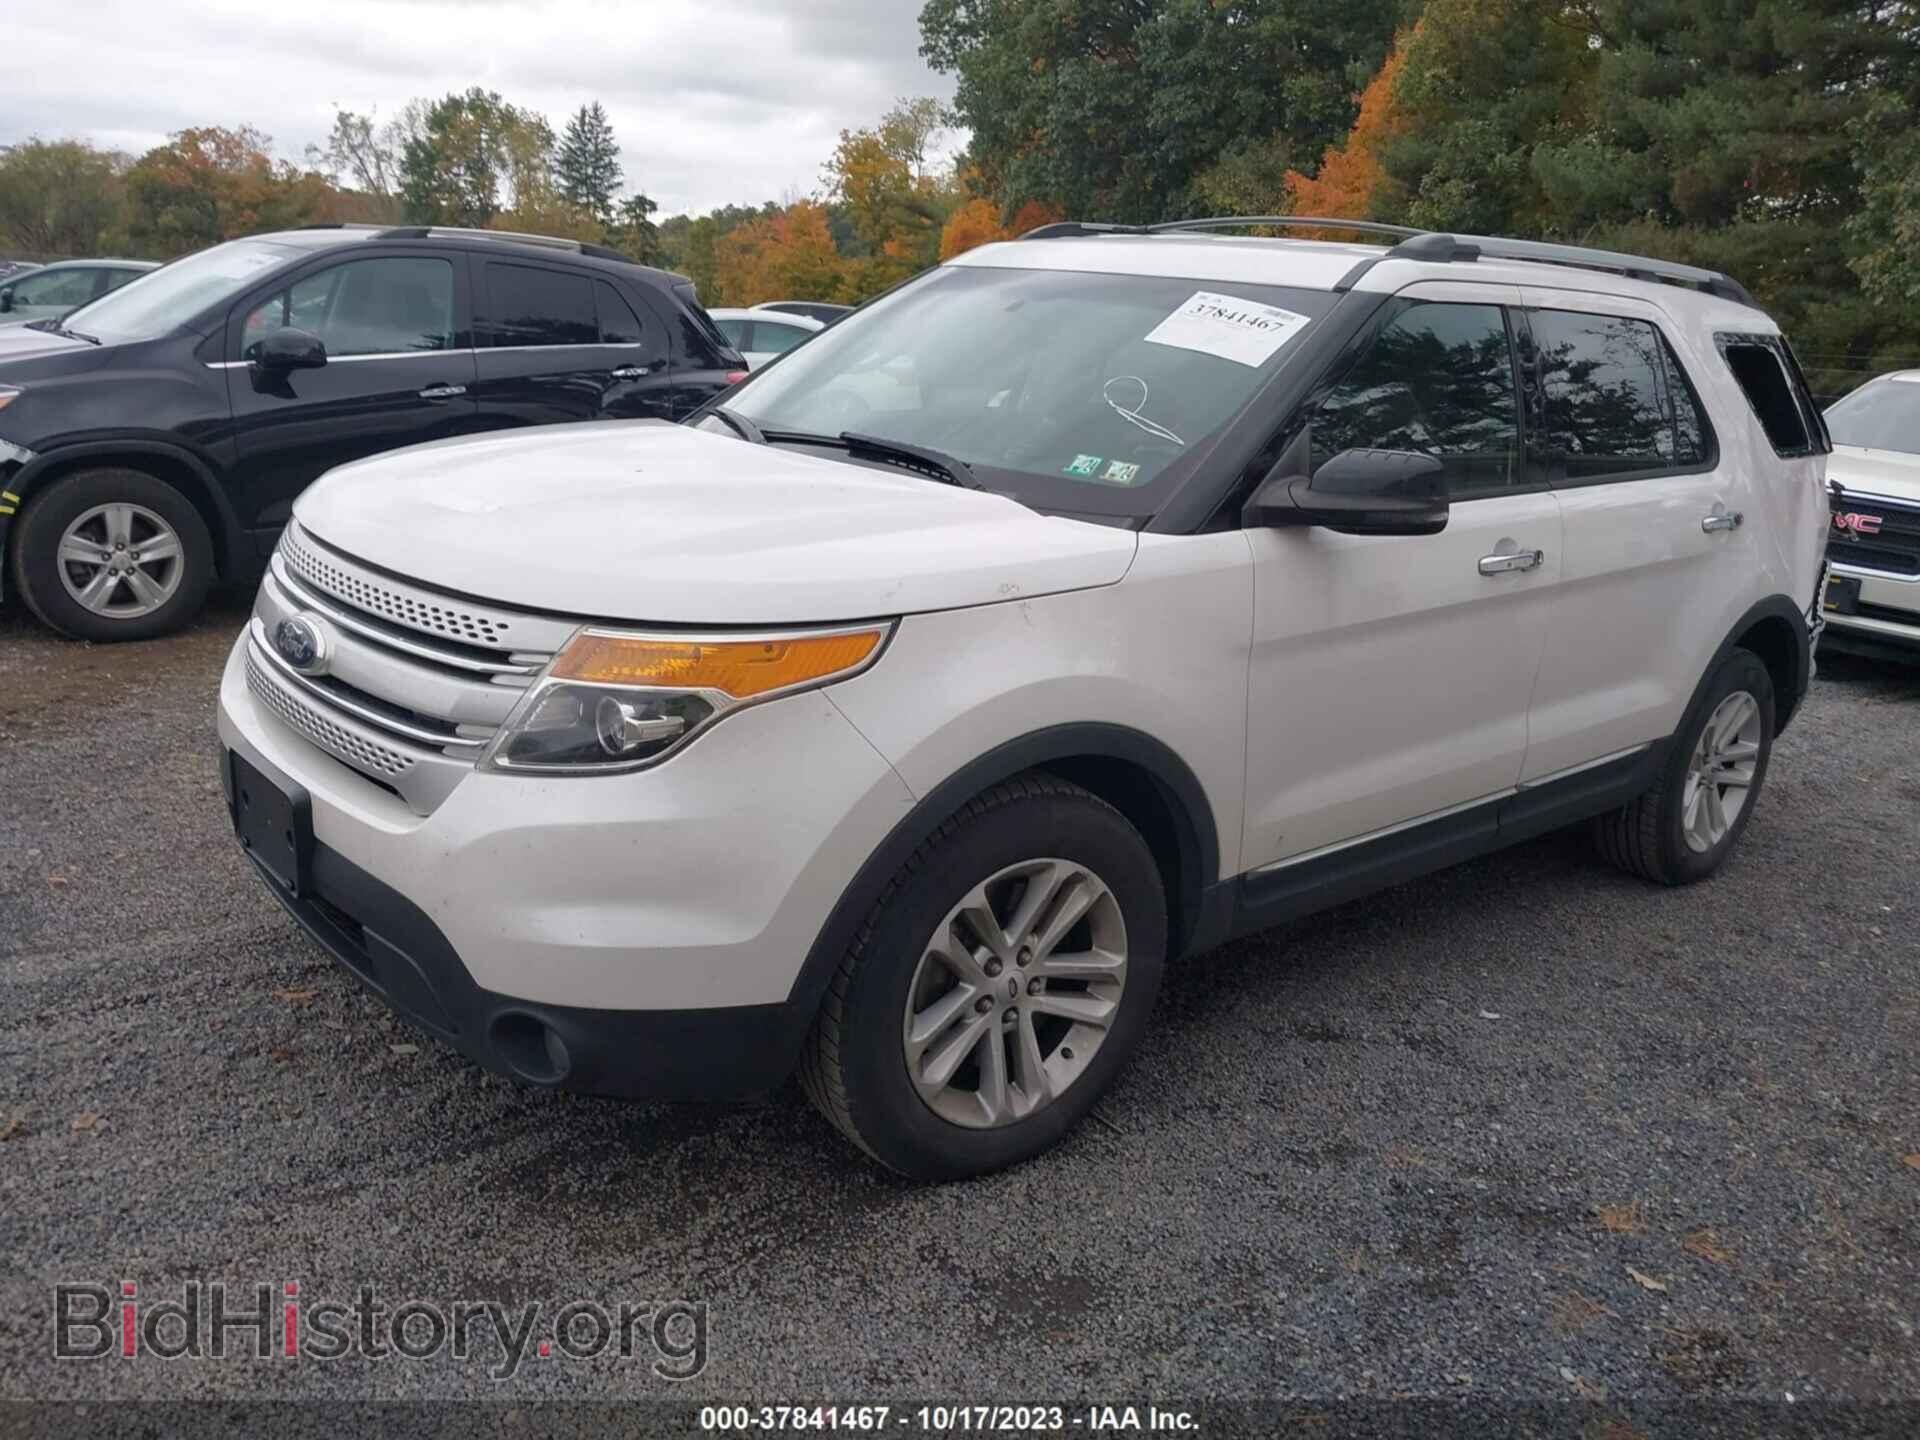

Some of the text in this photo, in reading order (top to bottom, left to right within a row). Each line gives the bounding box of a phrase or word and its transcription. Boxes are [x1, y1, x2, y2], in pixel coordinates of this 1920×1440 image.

[1189, 303, 1285, 332] 37841467
[1835, 512, 1882, 533] MC
[278, 622, 309, 659] Ford
